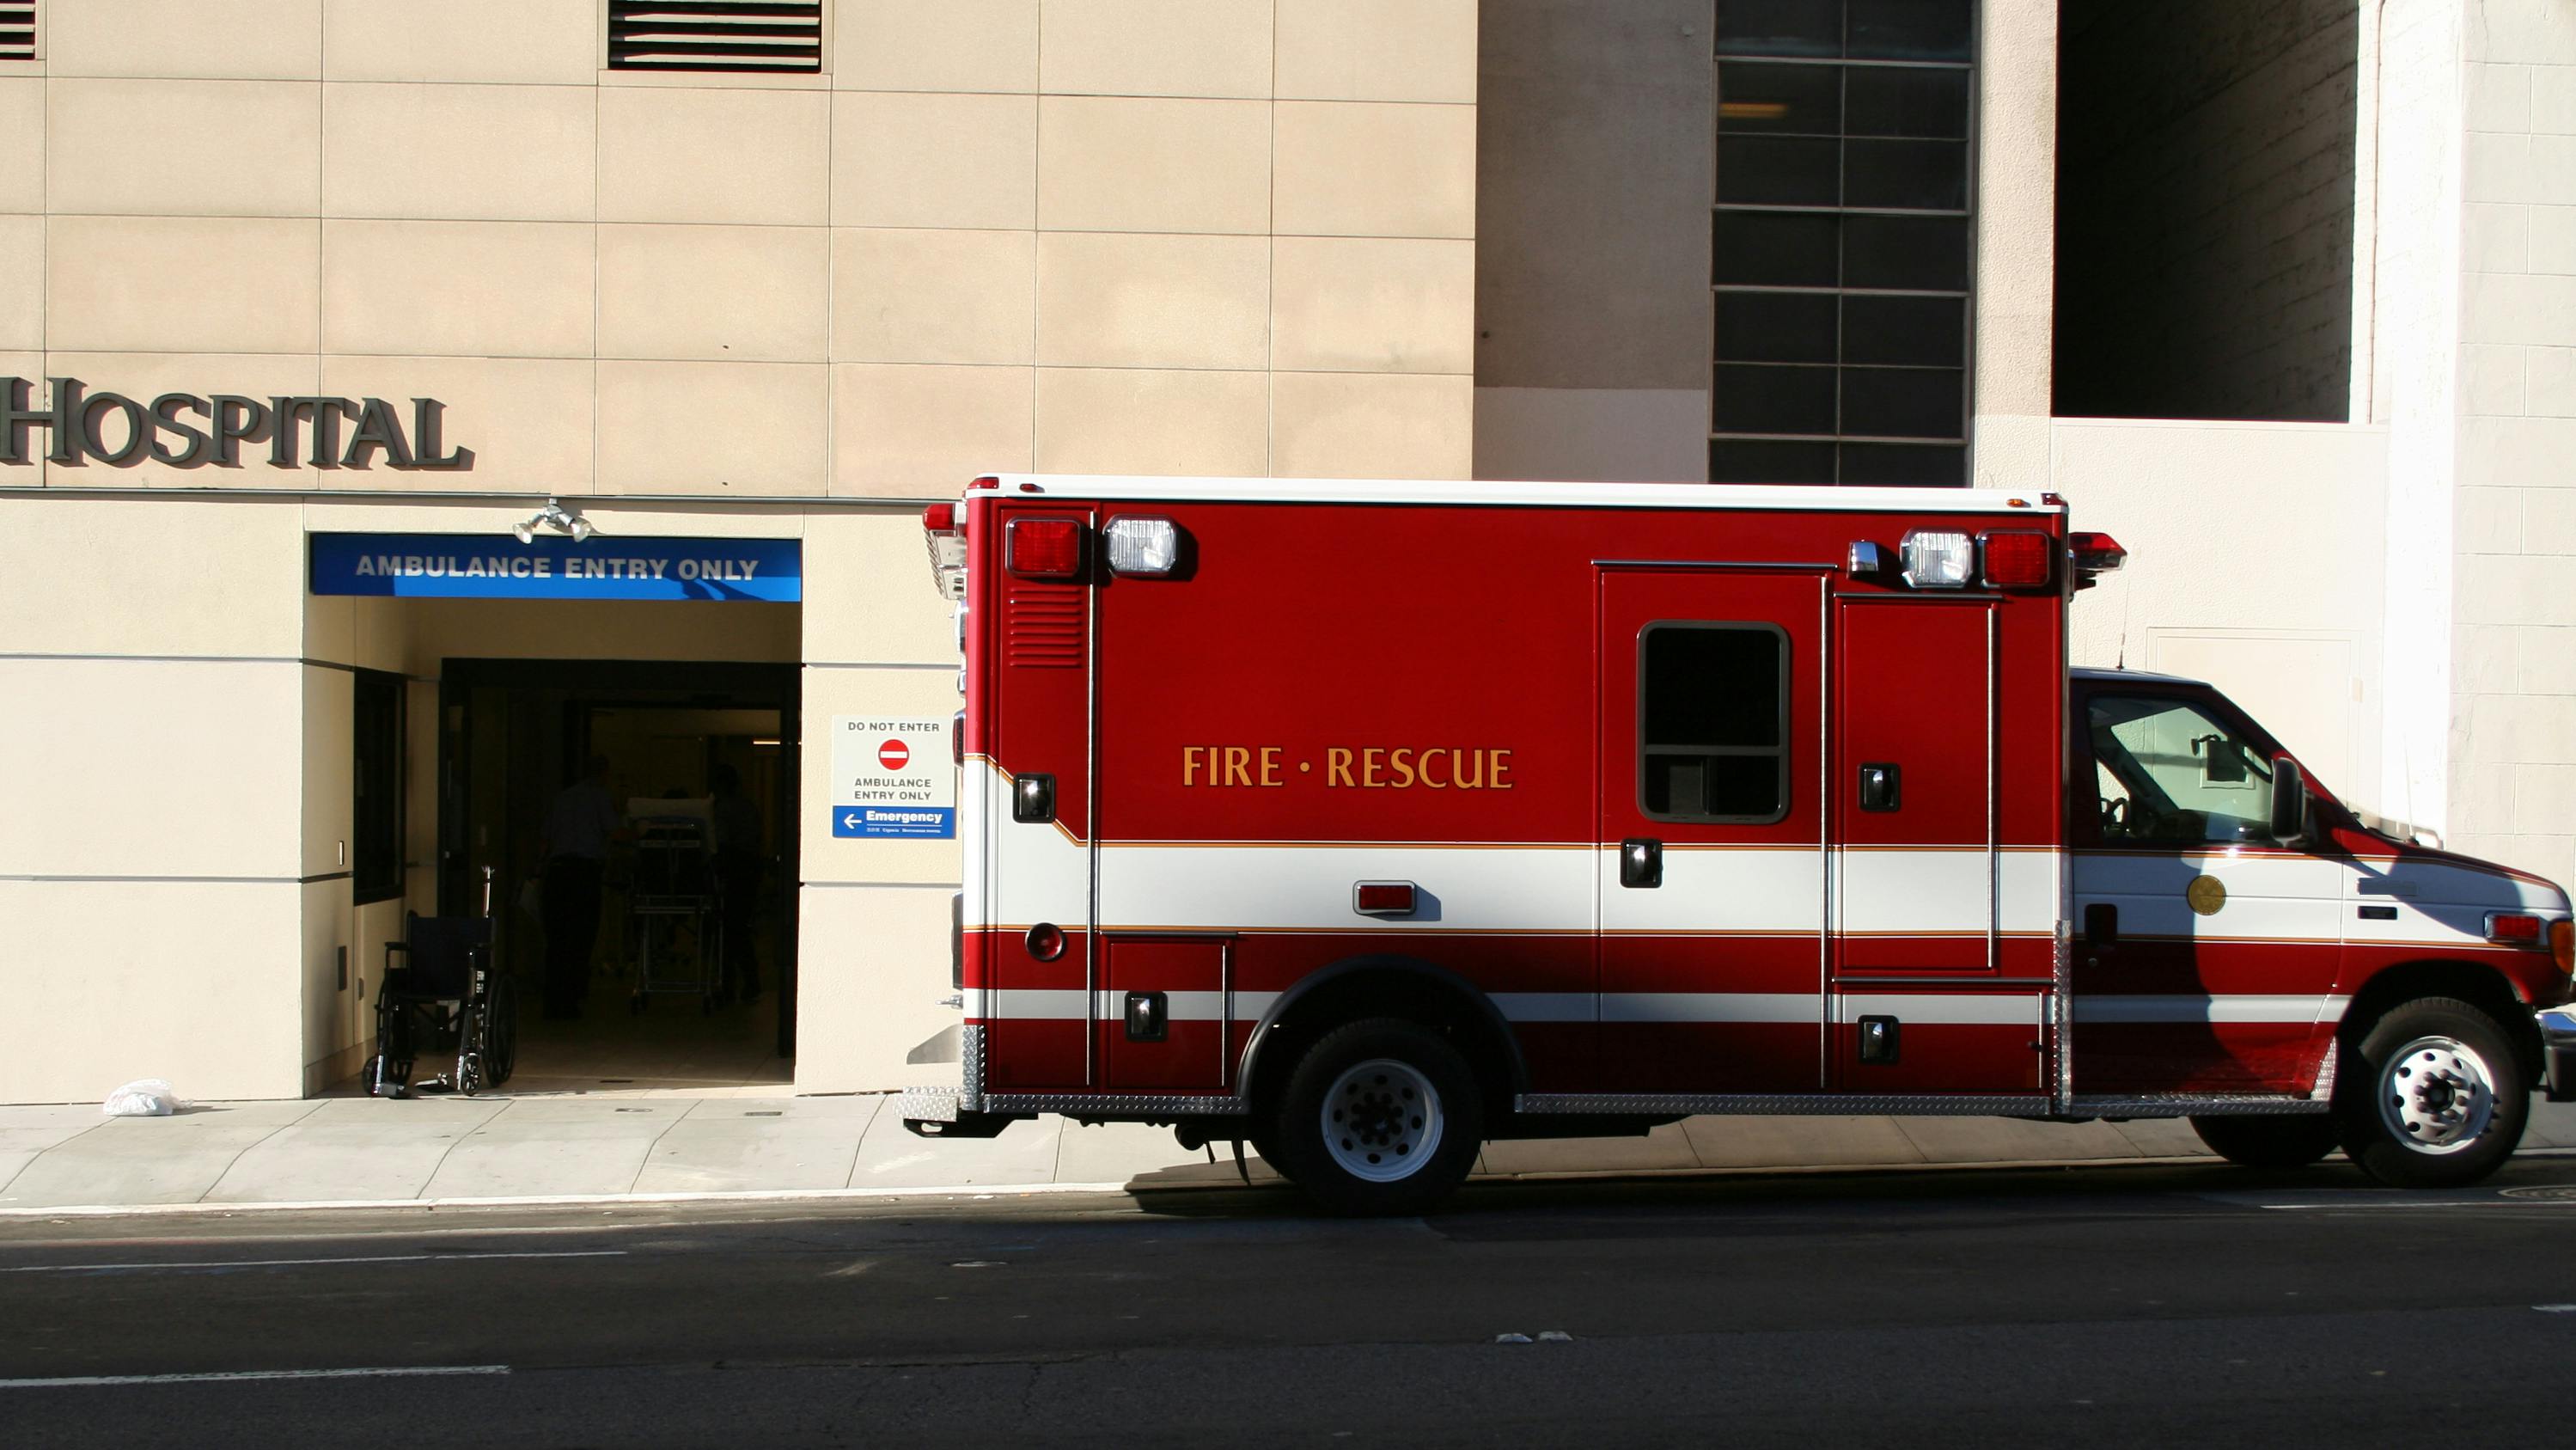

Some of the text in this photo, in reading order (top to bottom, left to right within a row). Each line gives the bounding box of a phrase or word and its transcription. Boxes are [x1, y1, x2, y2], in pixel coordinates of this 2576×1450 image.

[0, 376, 464, 466] HOSPITAL
[356, 555, 759, 581] AMBULANCE ENTRY ONLY
[847, 722, 940, 731] DO NOT ENTER
[1182, 746, 1285, 786] FIRE
[1328, 747, 1513, 789] RESCUE
[854, 778, 931, 787] AMBULANCE
[854, 791, 931, 800] ENTRY ONLY
[866, 810, 943, 824] Emergency
